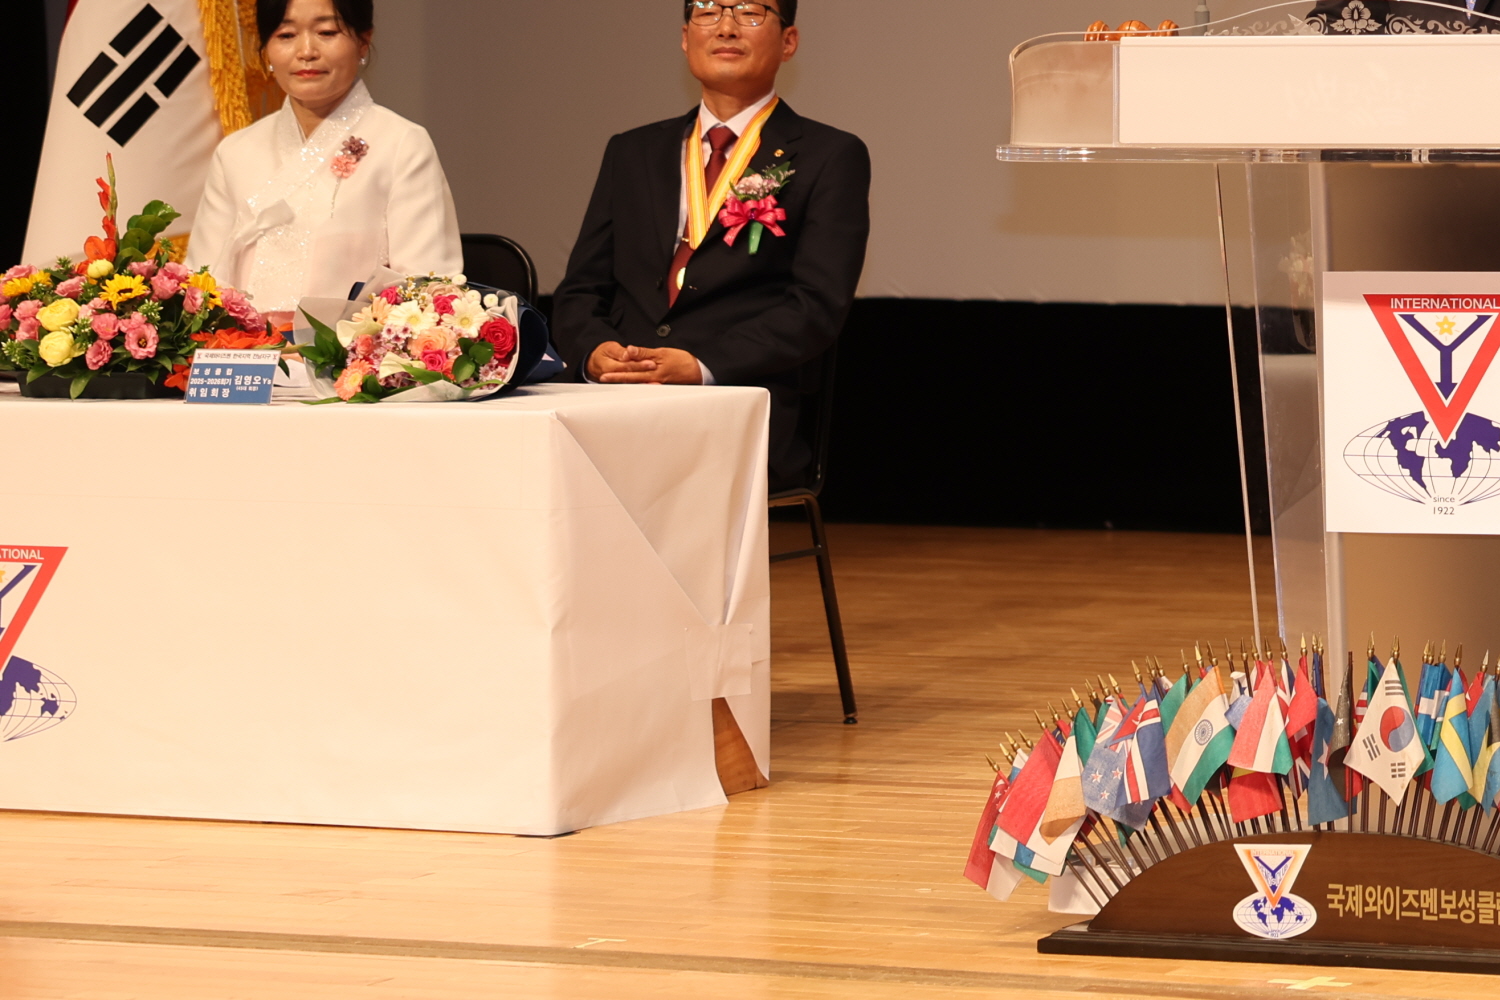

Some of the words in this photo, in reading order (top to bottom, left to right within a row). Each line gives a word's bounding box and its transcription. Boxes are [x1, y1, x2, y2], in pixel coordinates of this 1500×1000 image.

[1432, 494, 1456, 503] since
[1432, 506, 1456, 516] 1922
[0, 548, 45, 560] TIONAL
